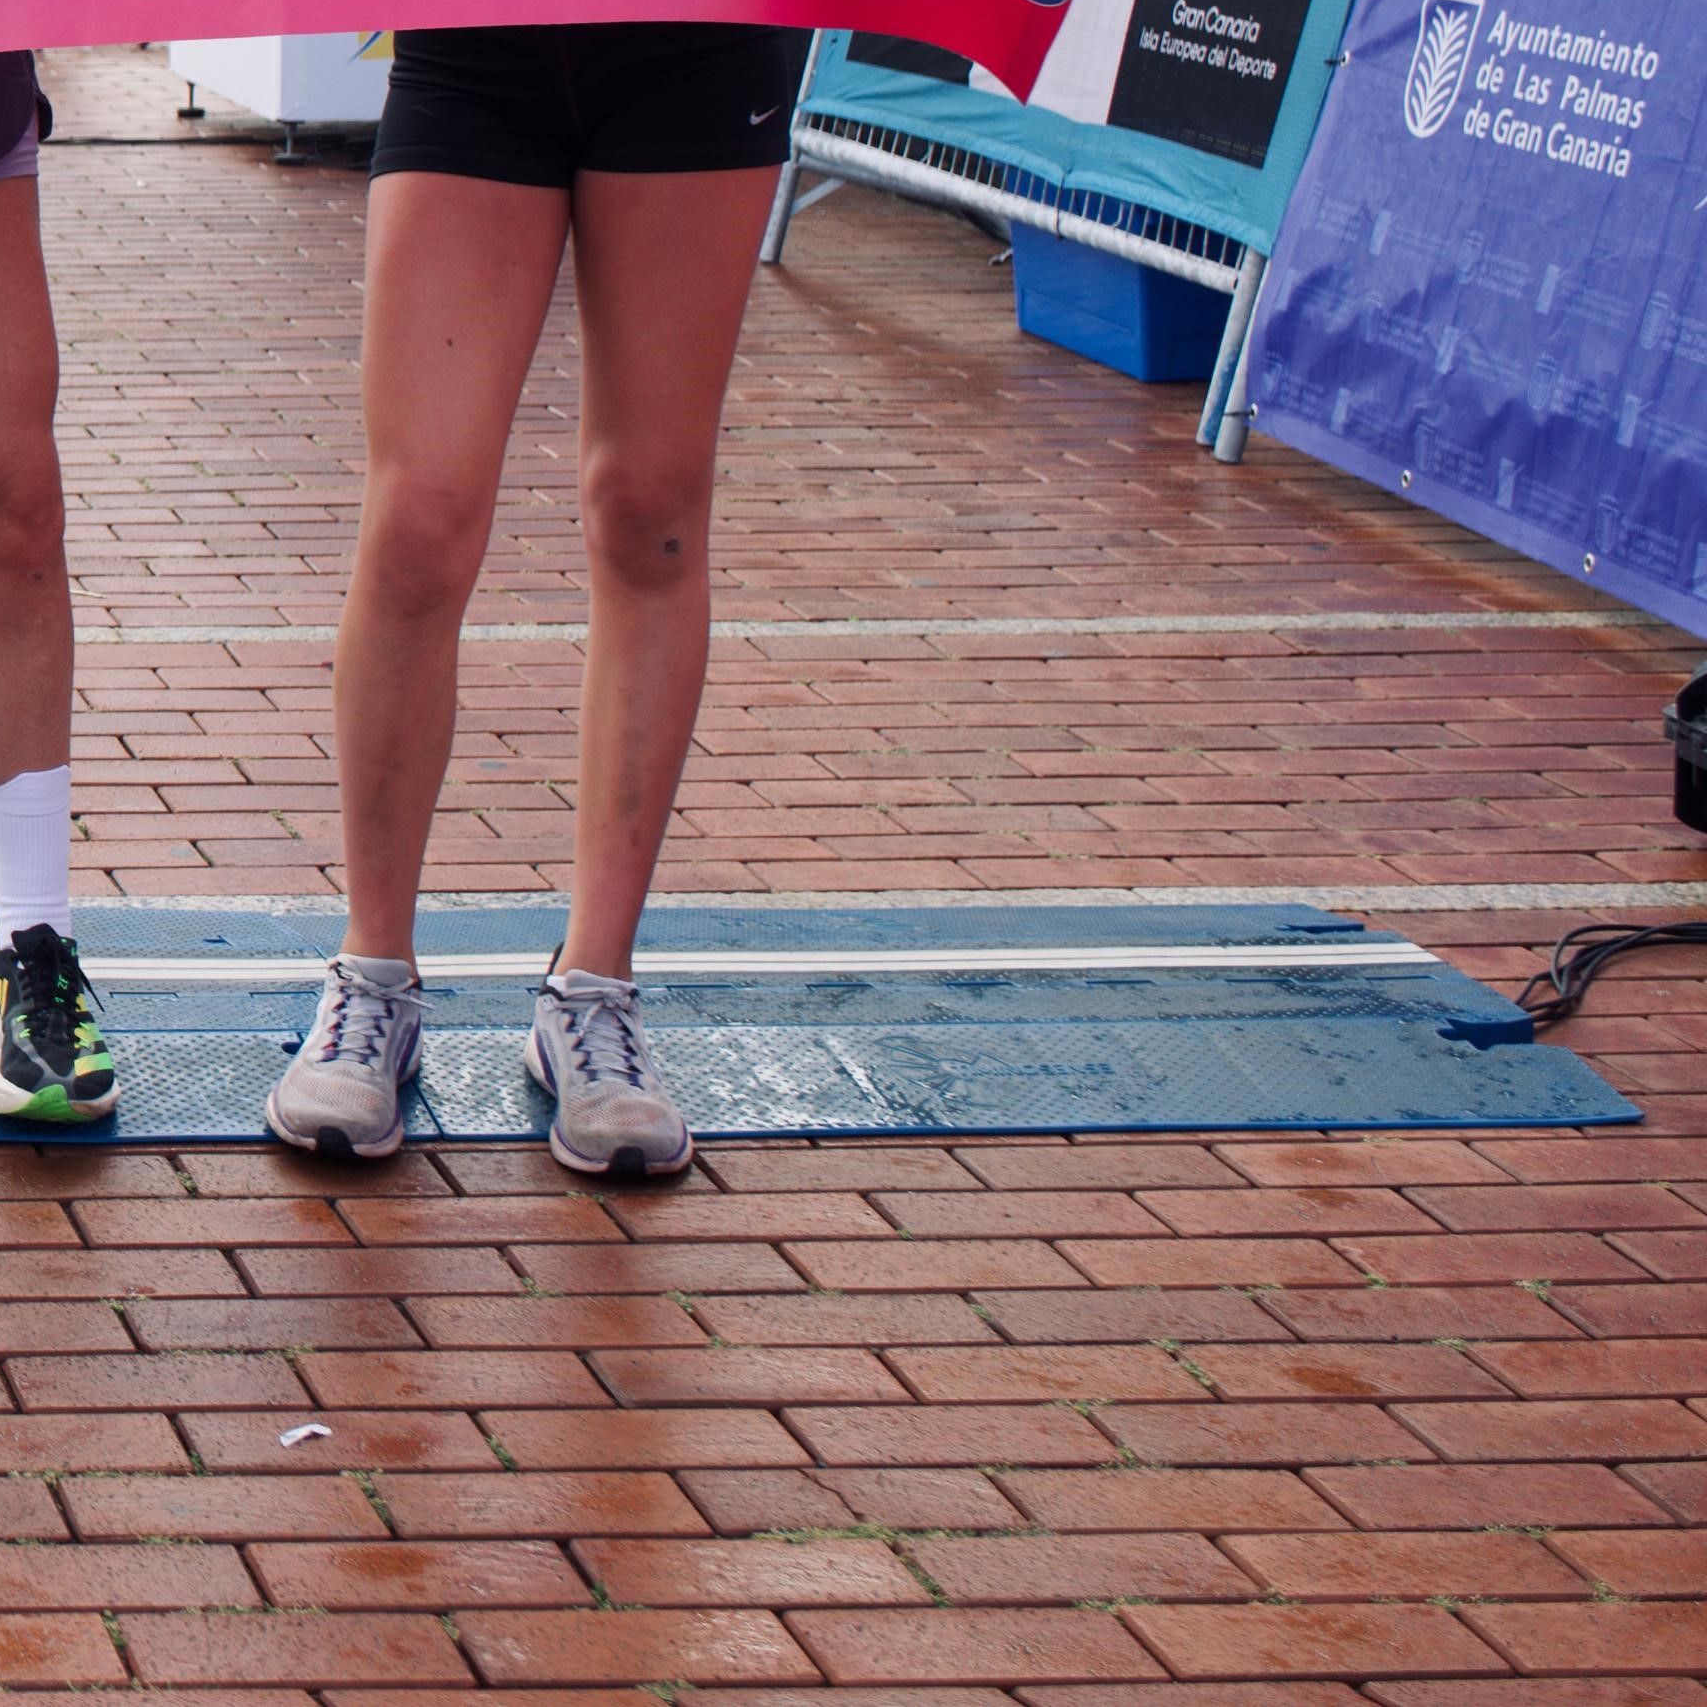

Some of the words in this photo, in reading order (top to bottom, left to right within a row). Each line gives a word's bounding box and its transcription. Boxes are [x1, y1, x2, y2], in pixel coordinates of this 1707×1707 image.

[1139, 26, 1159, 52] Isla
[1159, 31, 1208, 63] Europea
[1207, 43, 1229, 68] del
[1228, 47, 1277, 81] Deporte
[1487, 10, 1660, 80] Ayuntamiento
[1475, 54, 1505, 94] de
[1513, 63, 1553, 105] Las
[1559, 75, 1647, 129] Palmas
[1463, 99, 1491, 139] de
[1492, 108, 1543, 154] Gran
[1546, 122, 1632, 178] Canaria
